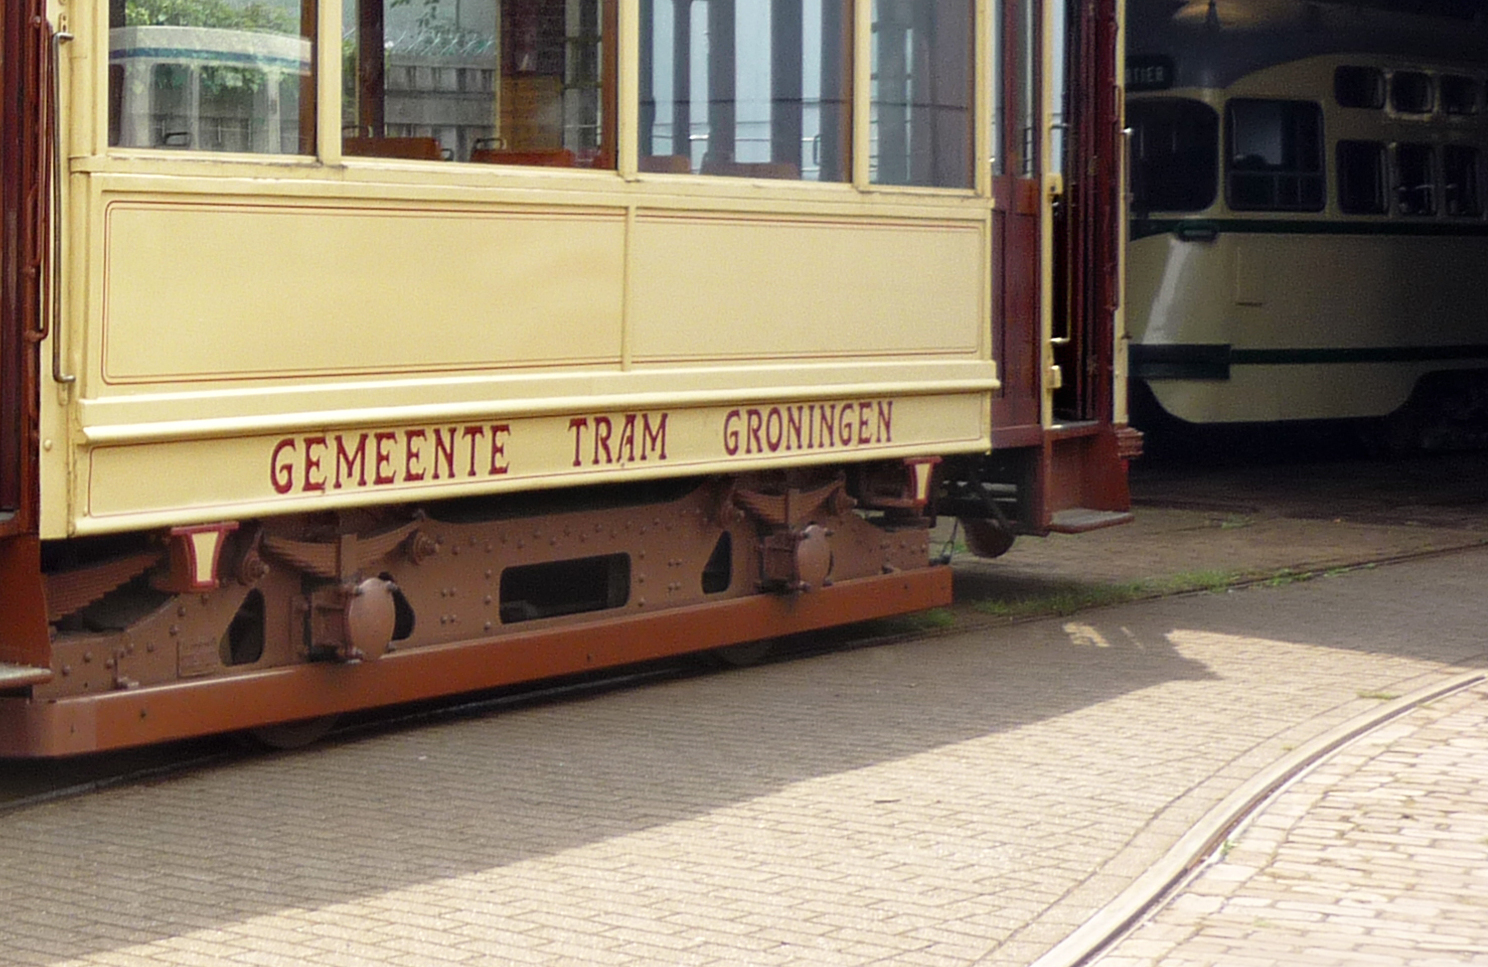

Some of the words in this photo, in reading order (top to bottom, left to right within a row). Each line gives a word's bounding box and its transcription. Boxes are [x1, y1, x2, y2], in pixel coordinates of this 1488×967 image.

[269, 423, 510, 494] GEMEENTE
[568, 412, 668, 467] TRAM
[723, 400, 893, 457] GRONINGEN
